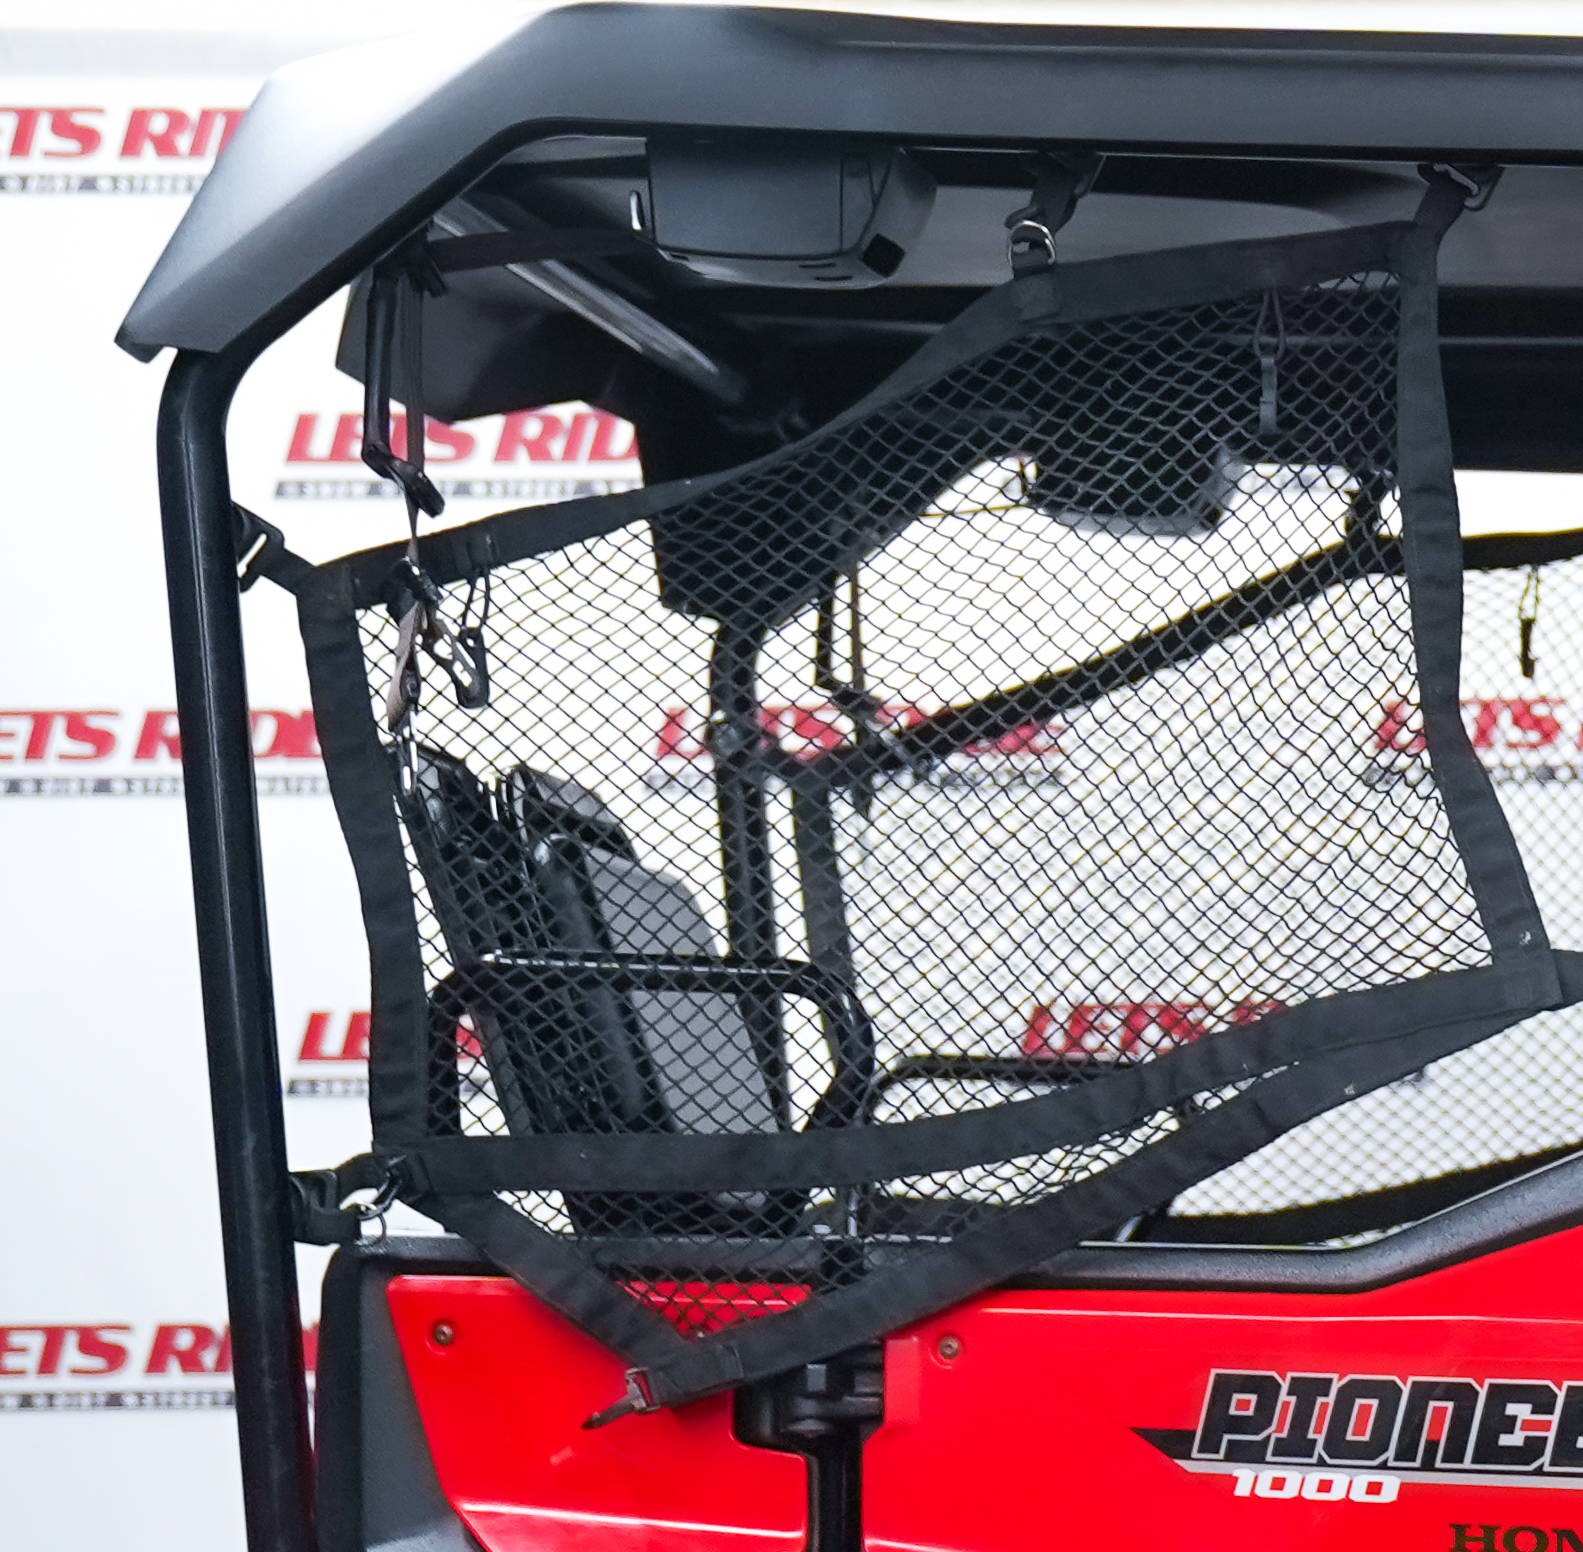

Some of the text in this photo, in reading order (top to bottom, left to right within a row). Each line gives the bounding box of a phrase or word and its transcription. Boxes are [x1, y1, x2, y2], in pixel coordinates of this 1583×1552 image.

[0, 107, 249, 158] TS RI
[493, 410, 639, 462] RID
[0, 711, 119, 761] TS
[0, 1325, 132, 1377] ETS
[1232, 1468, 1401, 1503] 1000
